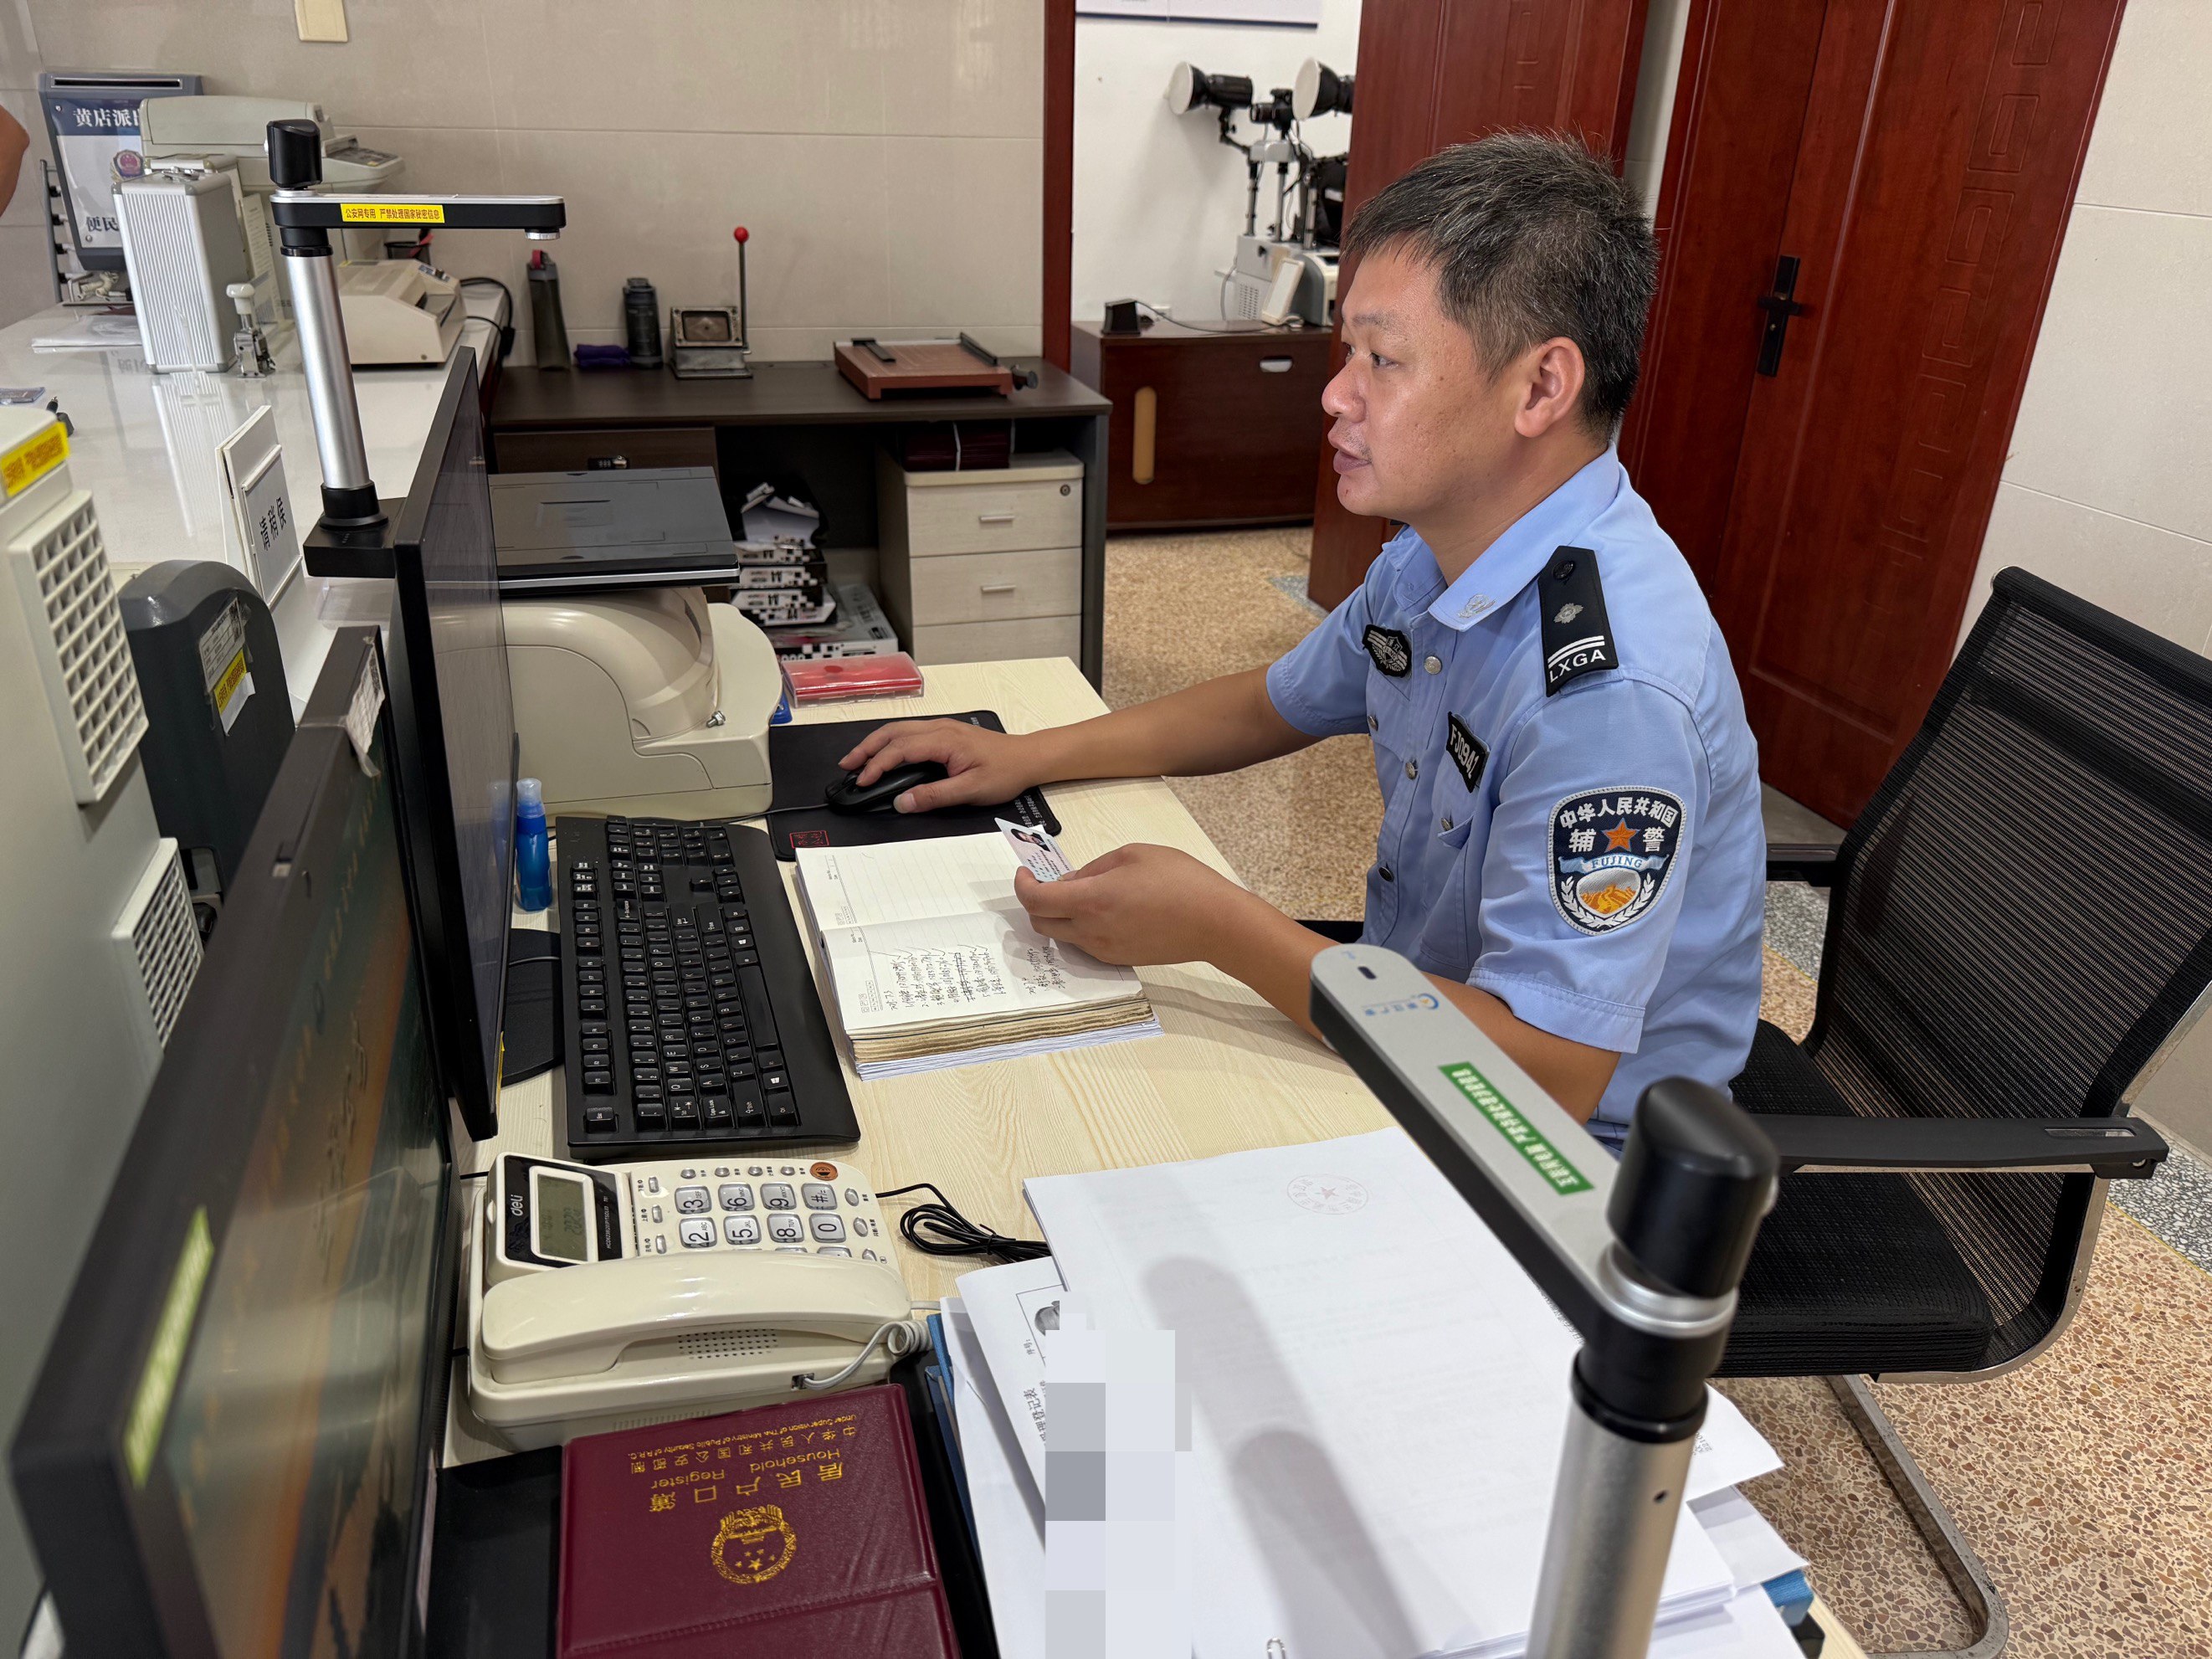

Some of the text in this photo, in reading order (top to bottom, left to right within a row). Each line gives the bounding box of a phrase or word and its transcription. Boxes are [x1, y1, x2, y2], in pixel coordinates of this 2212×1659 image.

[346, 208, 376, 218] 公安网专用
[1549, 649, 1606, 683] LXGA
[1450, 723, 1480, 779] FJ0941
[1559, 796, 1679, 829] 中华人民共和国
[1568, 826, 1665, 853] 辅 警
[1592, 855, 1643, 869] FUJING
[511, 1194, 524, 1216] deli
[684, 1199, 703, 1209] 3
[727, 1197, 747, 1206] 6
[770, 1198, 789, 1207] 9
[732, 1229, 753, 1238] 5
[777, 1228, 797, 1237] 8
[818, 1223, 837, 1232] 0
[689, 1232, 710, 1242] 2
[788, 1417, 841, 1432] Supervision
[841, 1414, 857, 1424] Under
[733, 1431, 762, 1441] Ministry
[664, 1441, 695, 1454] Security
[696, 1437, 722, 1448] Public
[631, 1425, 857, 1474] 中华人民共和国公安部制
[650, 1448, 841, 1489] Household Register
[649, 1461, 844, 1512] 居民户口簿
